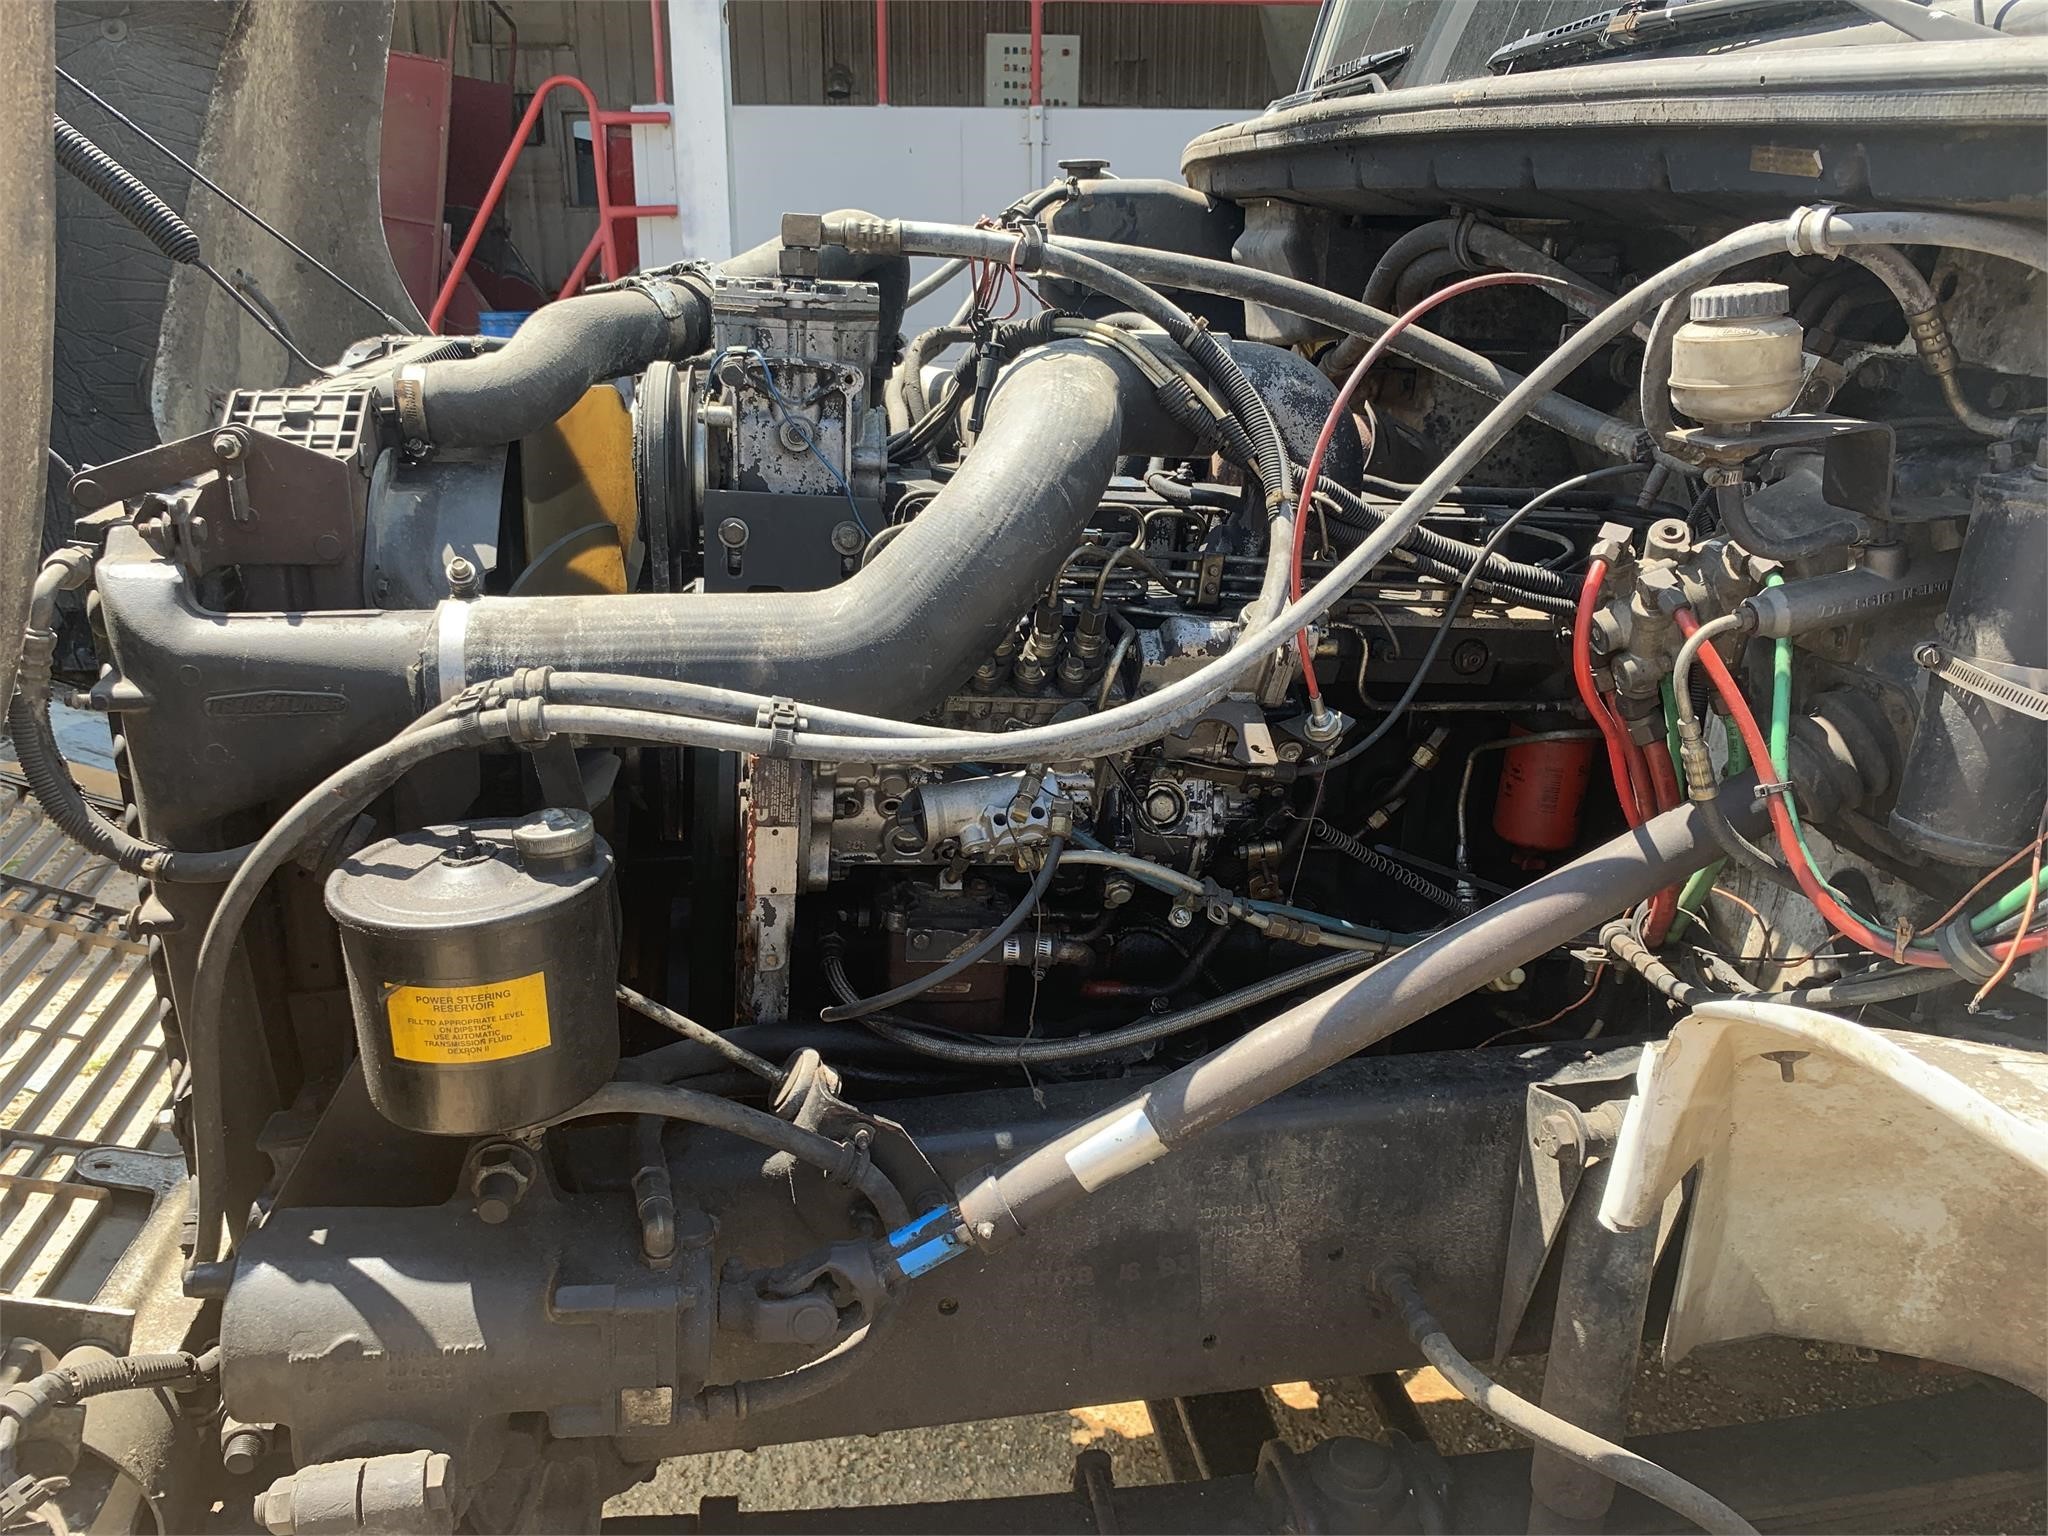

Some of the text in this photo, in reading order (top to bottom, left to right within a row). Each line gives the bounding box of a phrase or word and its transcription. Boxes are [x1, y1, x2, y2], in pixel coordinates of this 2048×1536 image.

[416, 989, 511, 1005] POWER STEERING
[433, 1001, 495, 1013] RESERVOIR
[439, 1016, 496, 1026] APPROPRIATE
[499, 1010, 525, 1021] LEVEL
[454, 1023, 493, 1033] DIPSTICK
[424, 1034, 513, 1047] TRANSMISSION FLUID
[453, 1029, 501, 1040] AUTOMATIC
[448, 1046, 483, 1054] DEXRON
